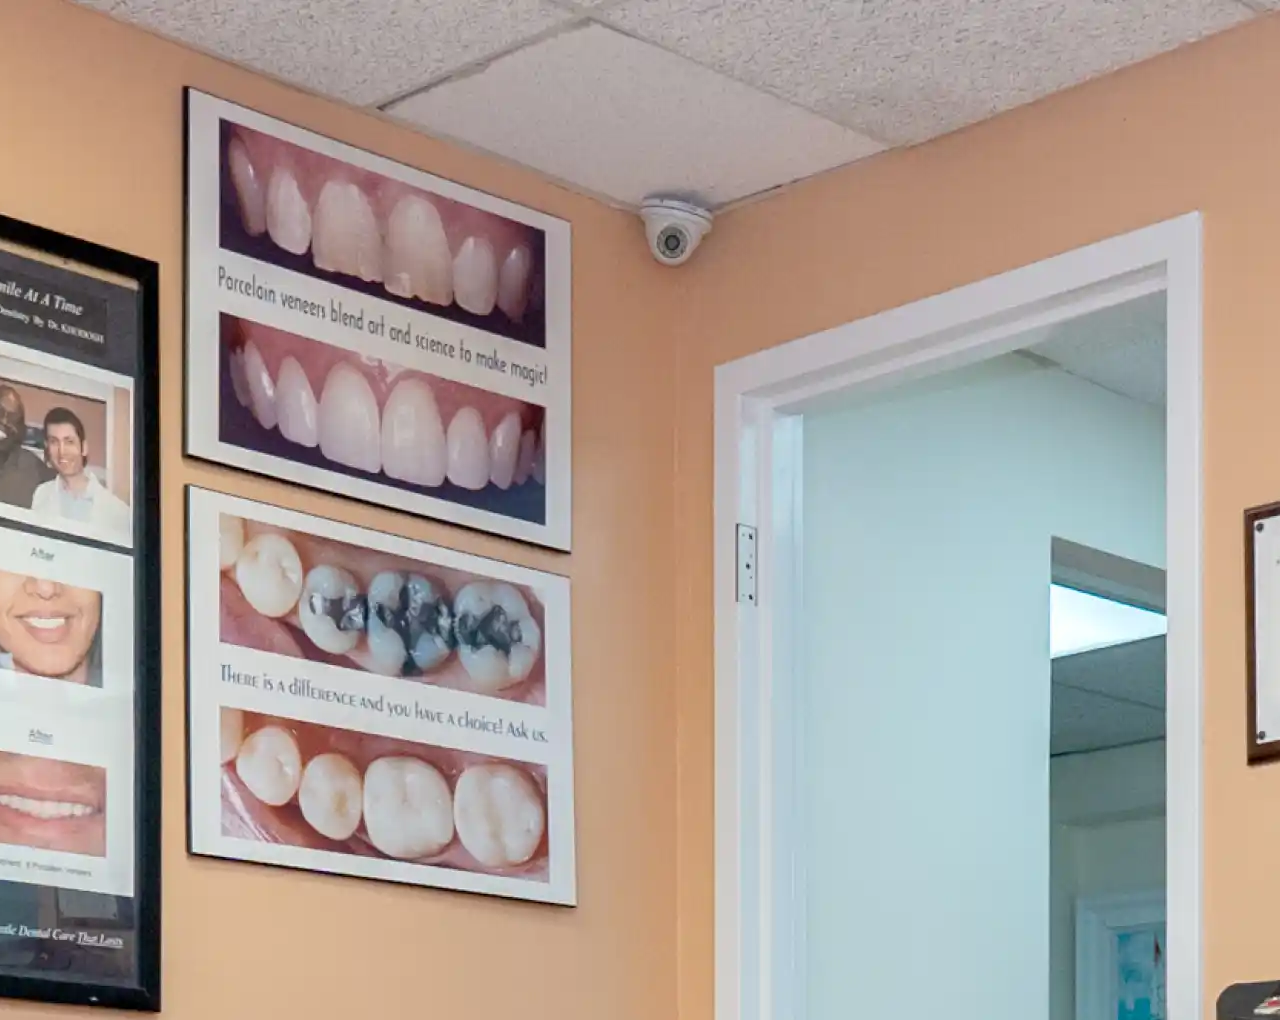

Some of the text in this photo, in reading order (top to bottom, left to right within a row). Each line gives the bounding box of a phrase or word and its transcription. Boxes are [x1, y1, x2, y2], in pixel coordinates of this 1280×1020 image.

[23, 288, 38, 303] At
[40, 293, 50, 306] A
[53, 294, 84, 316] Time
[218, 266, 548, 388] Porcelain veneers blend art and science to make magic!
[31, 546, 55, 562] After
[28, 727, 53, 744] After
[507, 720, 529, 741] Ask
[18, 925, 52, 939] Dental
[52, 929, 76, 942] Care
